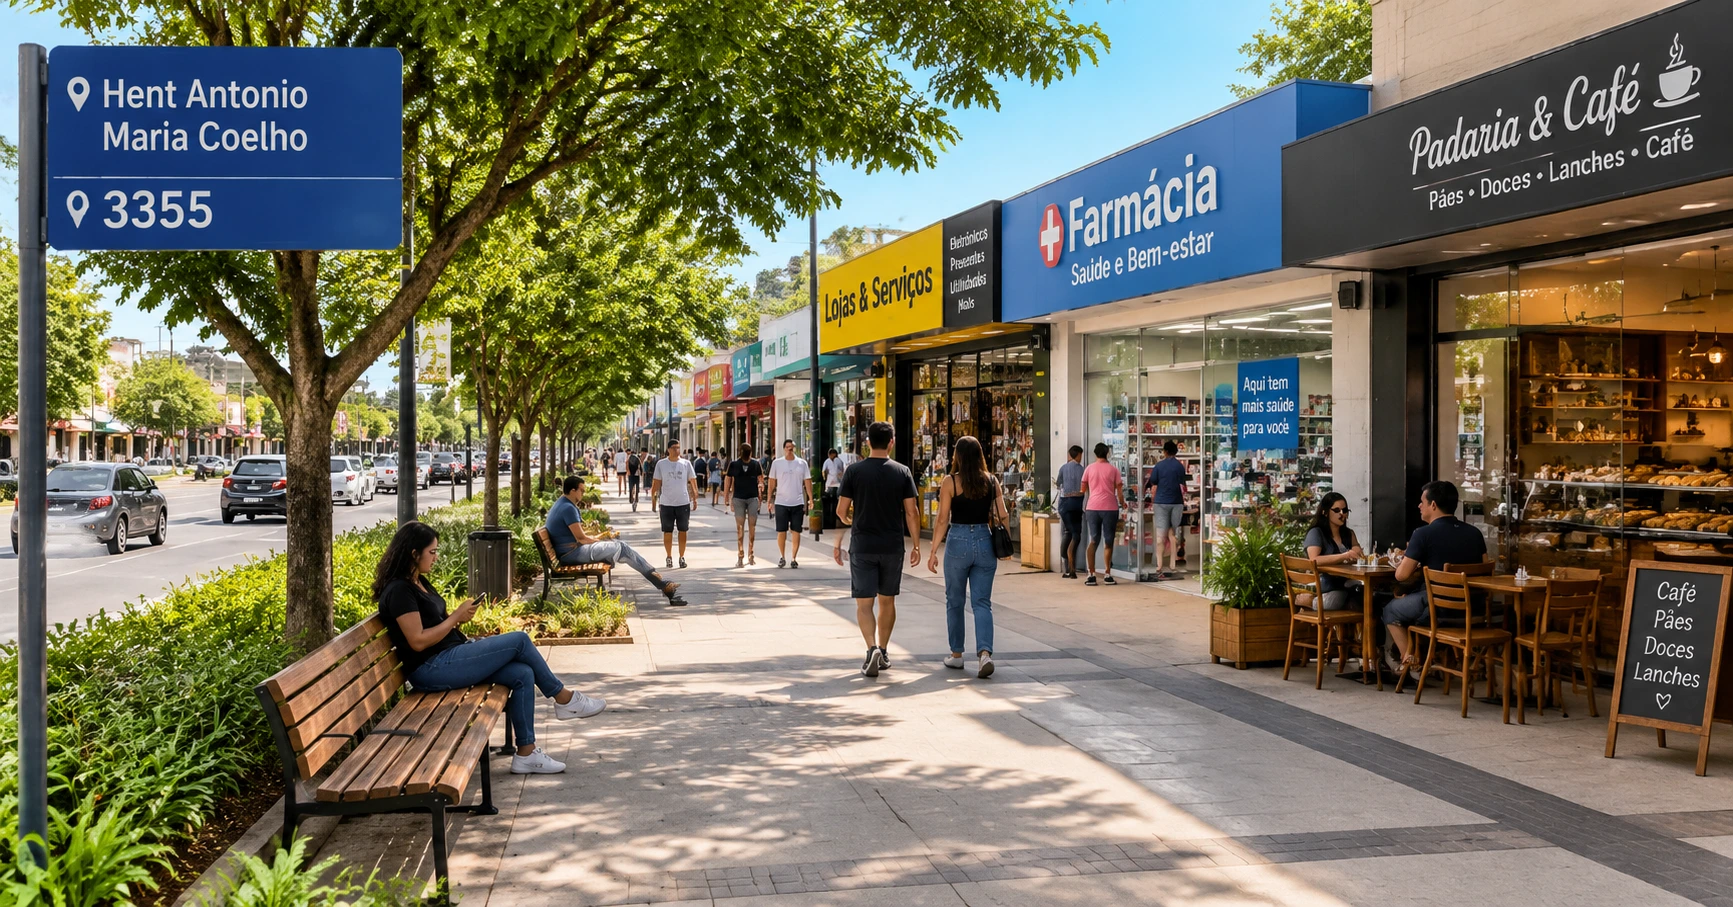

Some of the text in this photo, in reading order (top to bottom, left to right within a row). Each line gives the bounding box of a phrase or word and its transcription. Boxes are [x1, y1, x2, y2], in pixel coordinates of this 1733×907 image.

[104, 79, 307, 108] Hent Antonio
[1410, 63, 1640, 175] Padaria & Café
[104, 121, 307, 151] Maria Coelho
[1481, 173, 1530, 198] Doces
[1550, 150, 1624, 182] Lanches
[1647, 128, 1693, 158] Café
[104, 190, 212, 228] 3355
[1070, 154, 1216, 252] Farmácia
[1115, 257, 1123, 274] e
[1129, 231, 1213, 271] Bem-estar
[826, 266, 932, 327] Lojas & Serviços
[1243, 376, 1288, 395] Aqui tem
[1243, 398, 1264, 412] mais
[1243, 424, 1263, 438] para
[1658, 582, 1696, 607] Café
[1645, 636, 1694, 659] Doces
[1634, 662, 1700, 687] Lanches
